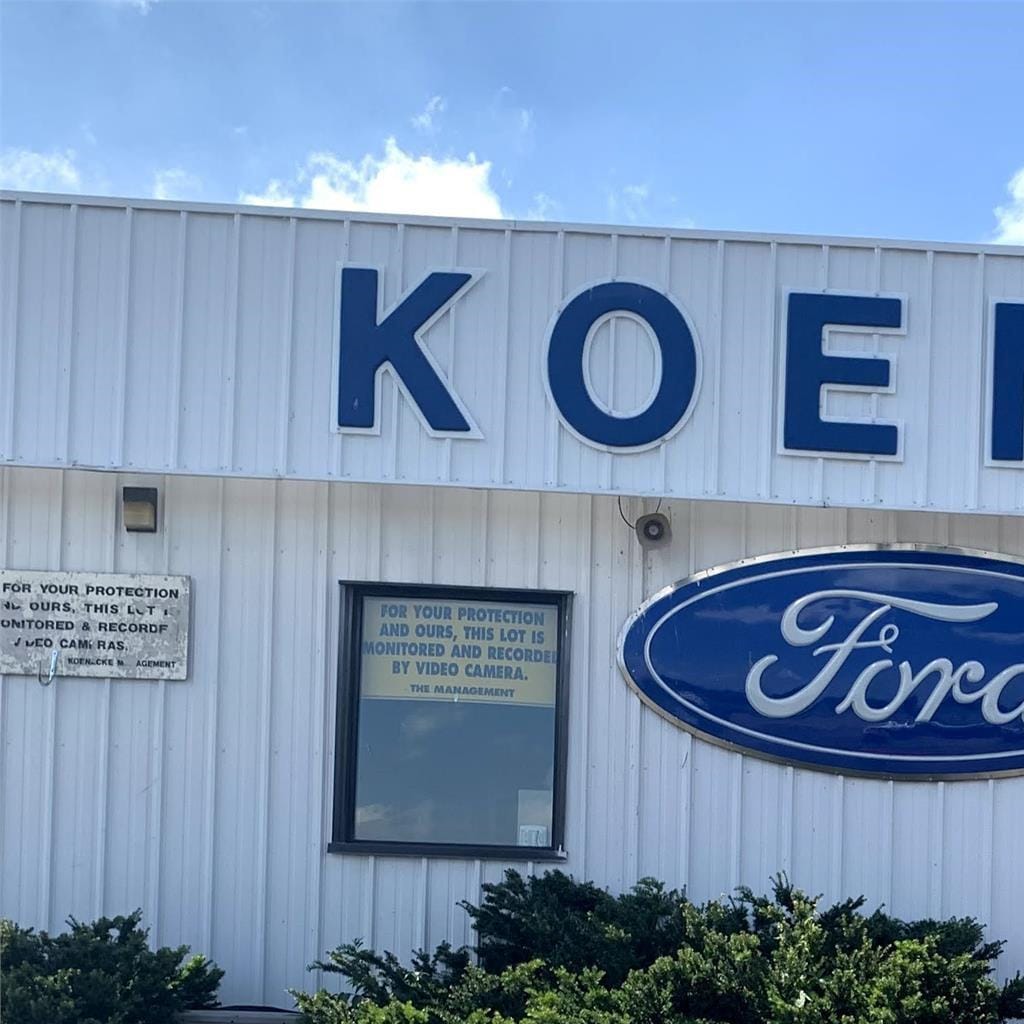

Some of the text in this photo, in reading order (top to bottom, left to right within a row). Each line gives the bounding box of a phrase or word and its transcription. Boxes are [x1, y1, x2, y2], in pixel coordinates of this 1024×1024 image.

[2, 582, 179, 599] FOR YOUR PROTECTION
[29, 601, 76, 614] OURS,
[84, 603, 119, 615] THIS
[381, 604, 545, 626] FOR YOUR PROTECTION
[0, 619, 74, 631] ONITORED
[81, 621, 91, 632] &
[379, 623, 545, 645] AND OURS, THIS LOT IS
[362, 641, 445, 657] MONITORED
[451, 644, 482, 659] AND
[117, 659, 177, 668] MAGEMENT
[392, 660, 528, 681] BY VIDEO CAMERA.
[410, 684, 515, 698] THE MANAGEMENT
